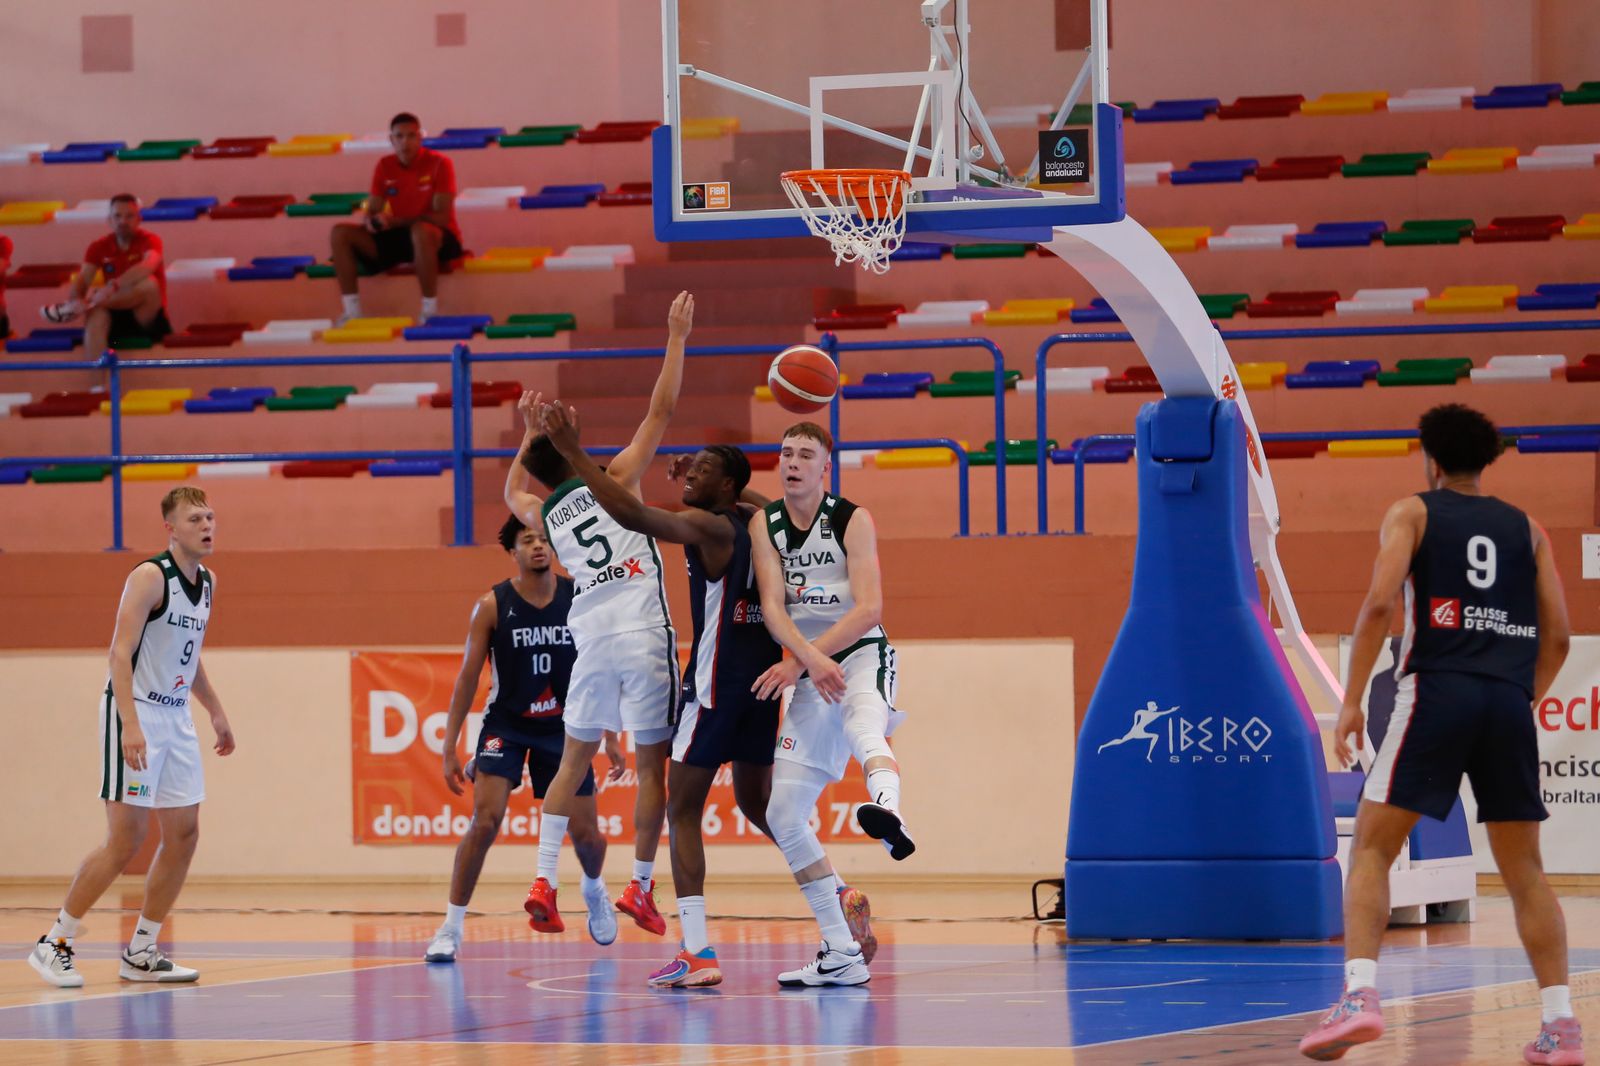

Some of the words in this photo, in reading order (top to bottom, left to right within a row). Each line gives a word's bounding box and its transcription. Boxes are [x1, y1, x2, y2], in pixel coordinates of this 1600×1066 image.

[1045, 161, 1085, 170] baloncesto
[548, 490, 597, 530] KUBLICKA
[571, 515, 614, 570] 5
[1466, 535, 1497, 589] 9
[802, 594, 841, 605] VELA
[1463, 606, 1508, 622] CAISSE
[512, 625, 572, 648] FRANCE
[1463, 618, 1537, 638] D'EPARGNE
[180, 640, 194, 666] 9
[532, 653, 552, 675] 10
[1536, 686, 1600, 731] ech
[1168, 716, 1272, 754] IBERO
[1169, 755, 1272, 763] SPORT
